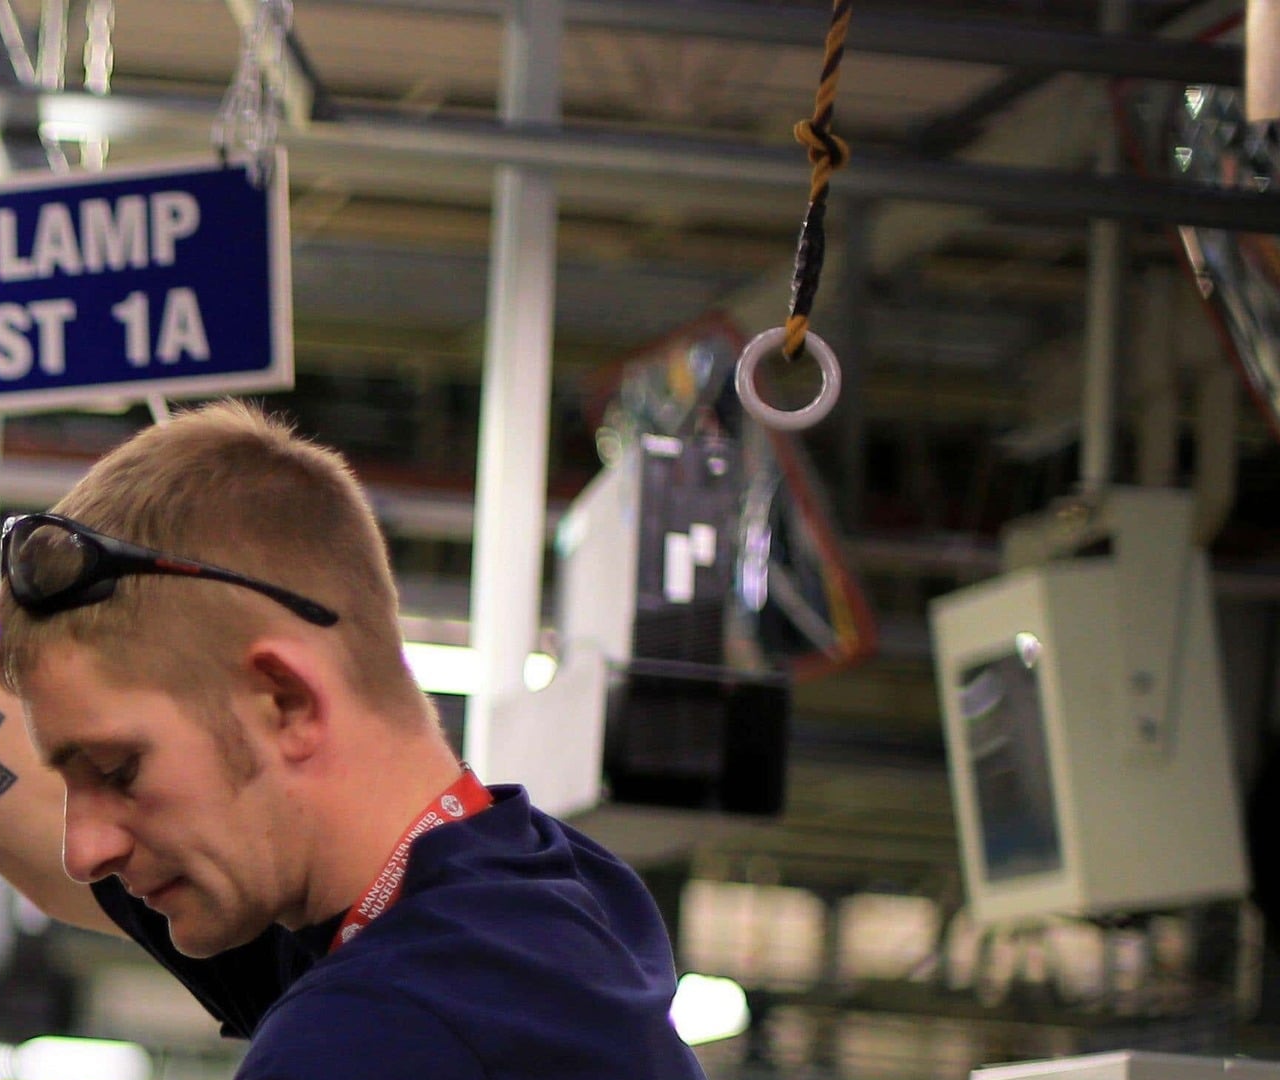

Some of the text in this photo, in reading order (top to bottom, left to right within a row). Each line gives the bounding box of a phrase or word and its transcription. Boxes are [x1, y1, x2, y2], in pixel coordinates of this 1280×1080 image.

[111, 285, 211, 368] 1A
[358, 842, 410, 915] MANCHESTER
[405, 811, 438, 842] UNITED
[368, 867, 406, 921] MUSEUM
